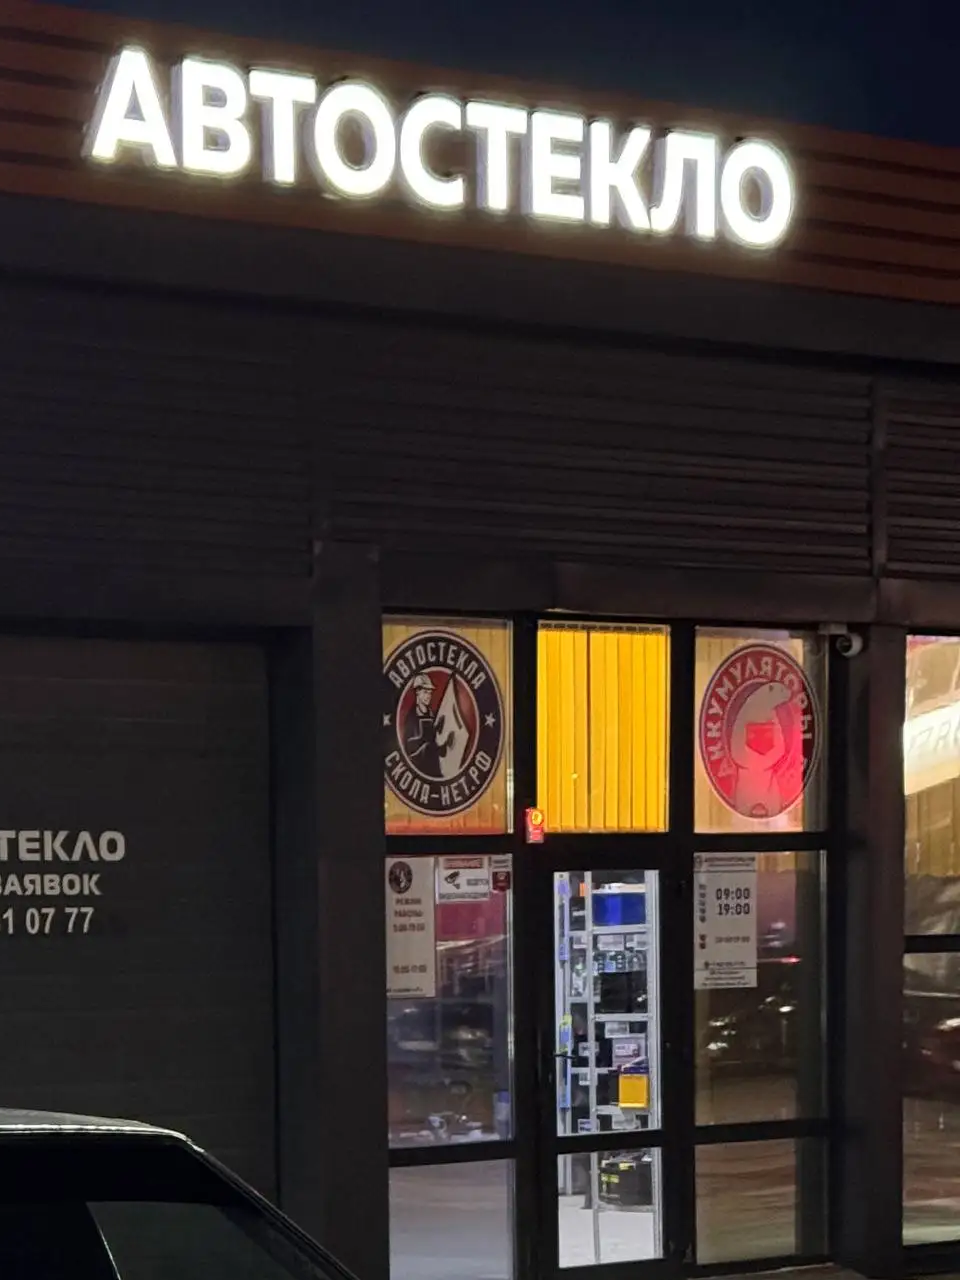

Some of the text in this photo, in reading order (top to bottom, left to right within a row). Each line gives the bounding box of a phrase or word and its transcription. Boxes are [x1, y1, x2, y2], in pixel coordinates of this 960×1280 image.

[89, 45, 796, 249] АВТОСТЕКЛО
[388, 641, 486, 690] АВТОСТЕКЛА
[715, 888, 751, 900] 09:00
[26, 907, 56, 934] 07
[65, 907, 95, 933] 77
[717, 903, 751, 915] 19:00
